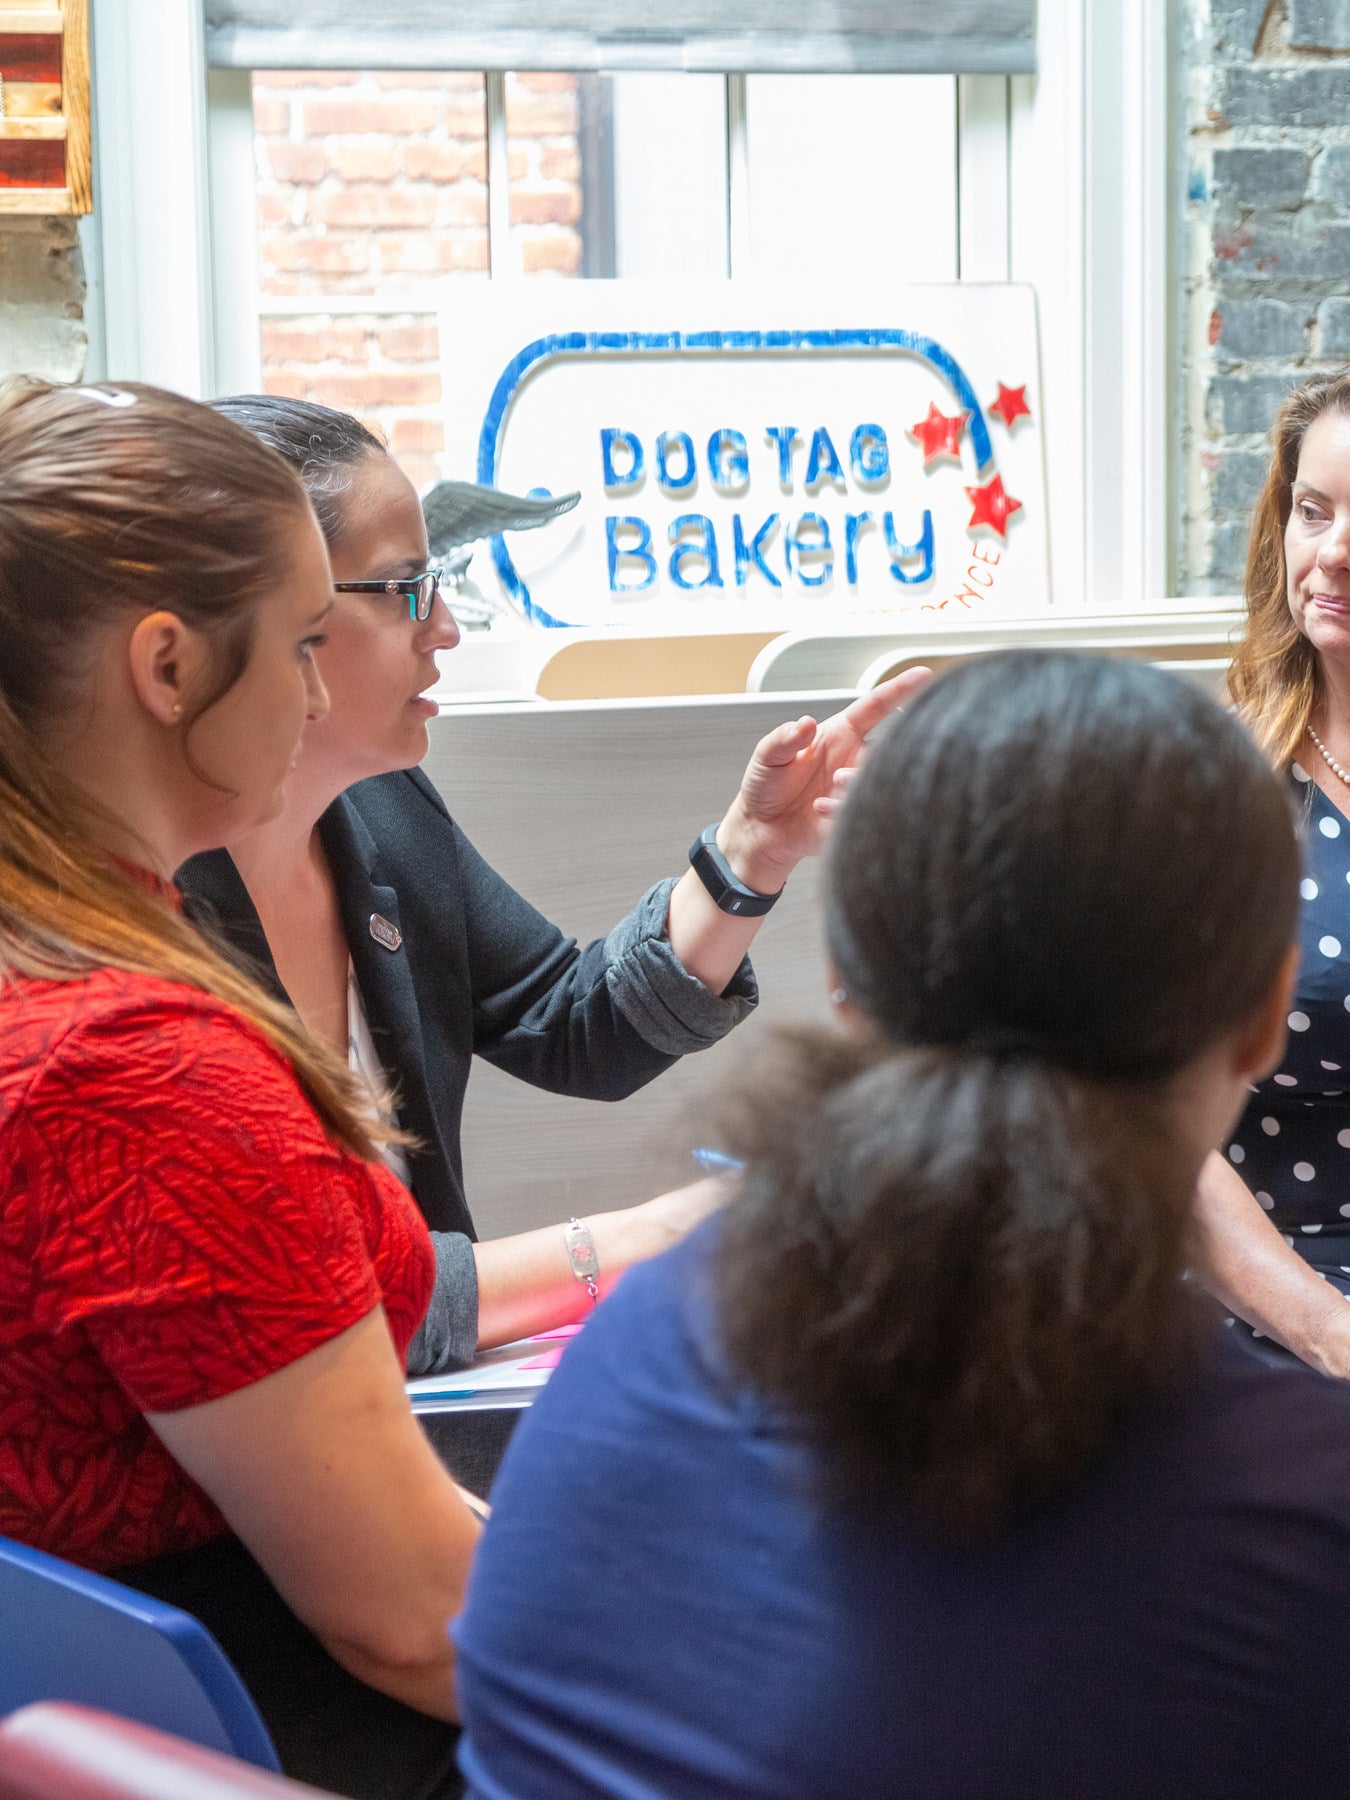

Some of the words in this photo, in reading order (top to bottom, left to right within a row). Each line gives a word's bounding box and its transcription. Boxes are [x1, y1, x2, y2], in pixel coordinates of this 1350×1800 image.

[600, 428, 749, 488] DOG
[765, 423, 890, 484] TAG
[605, 509, 935, 592] Bakery
